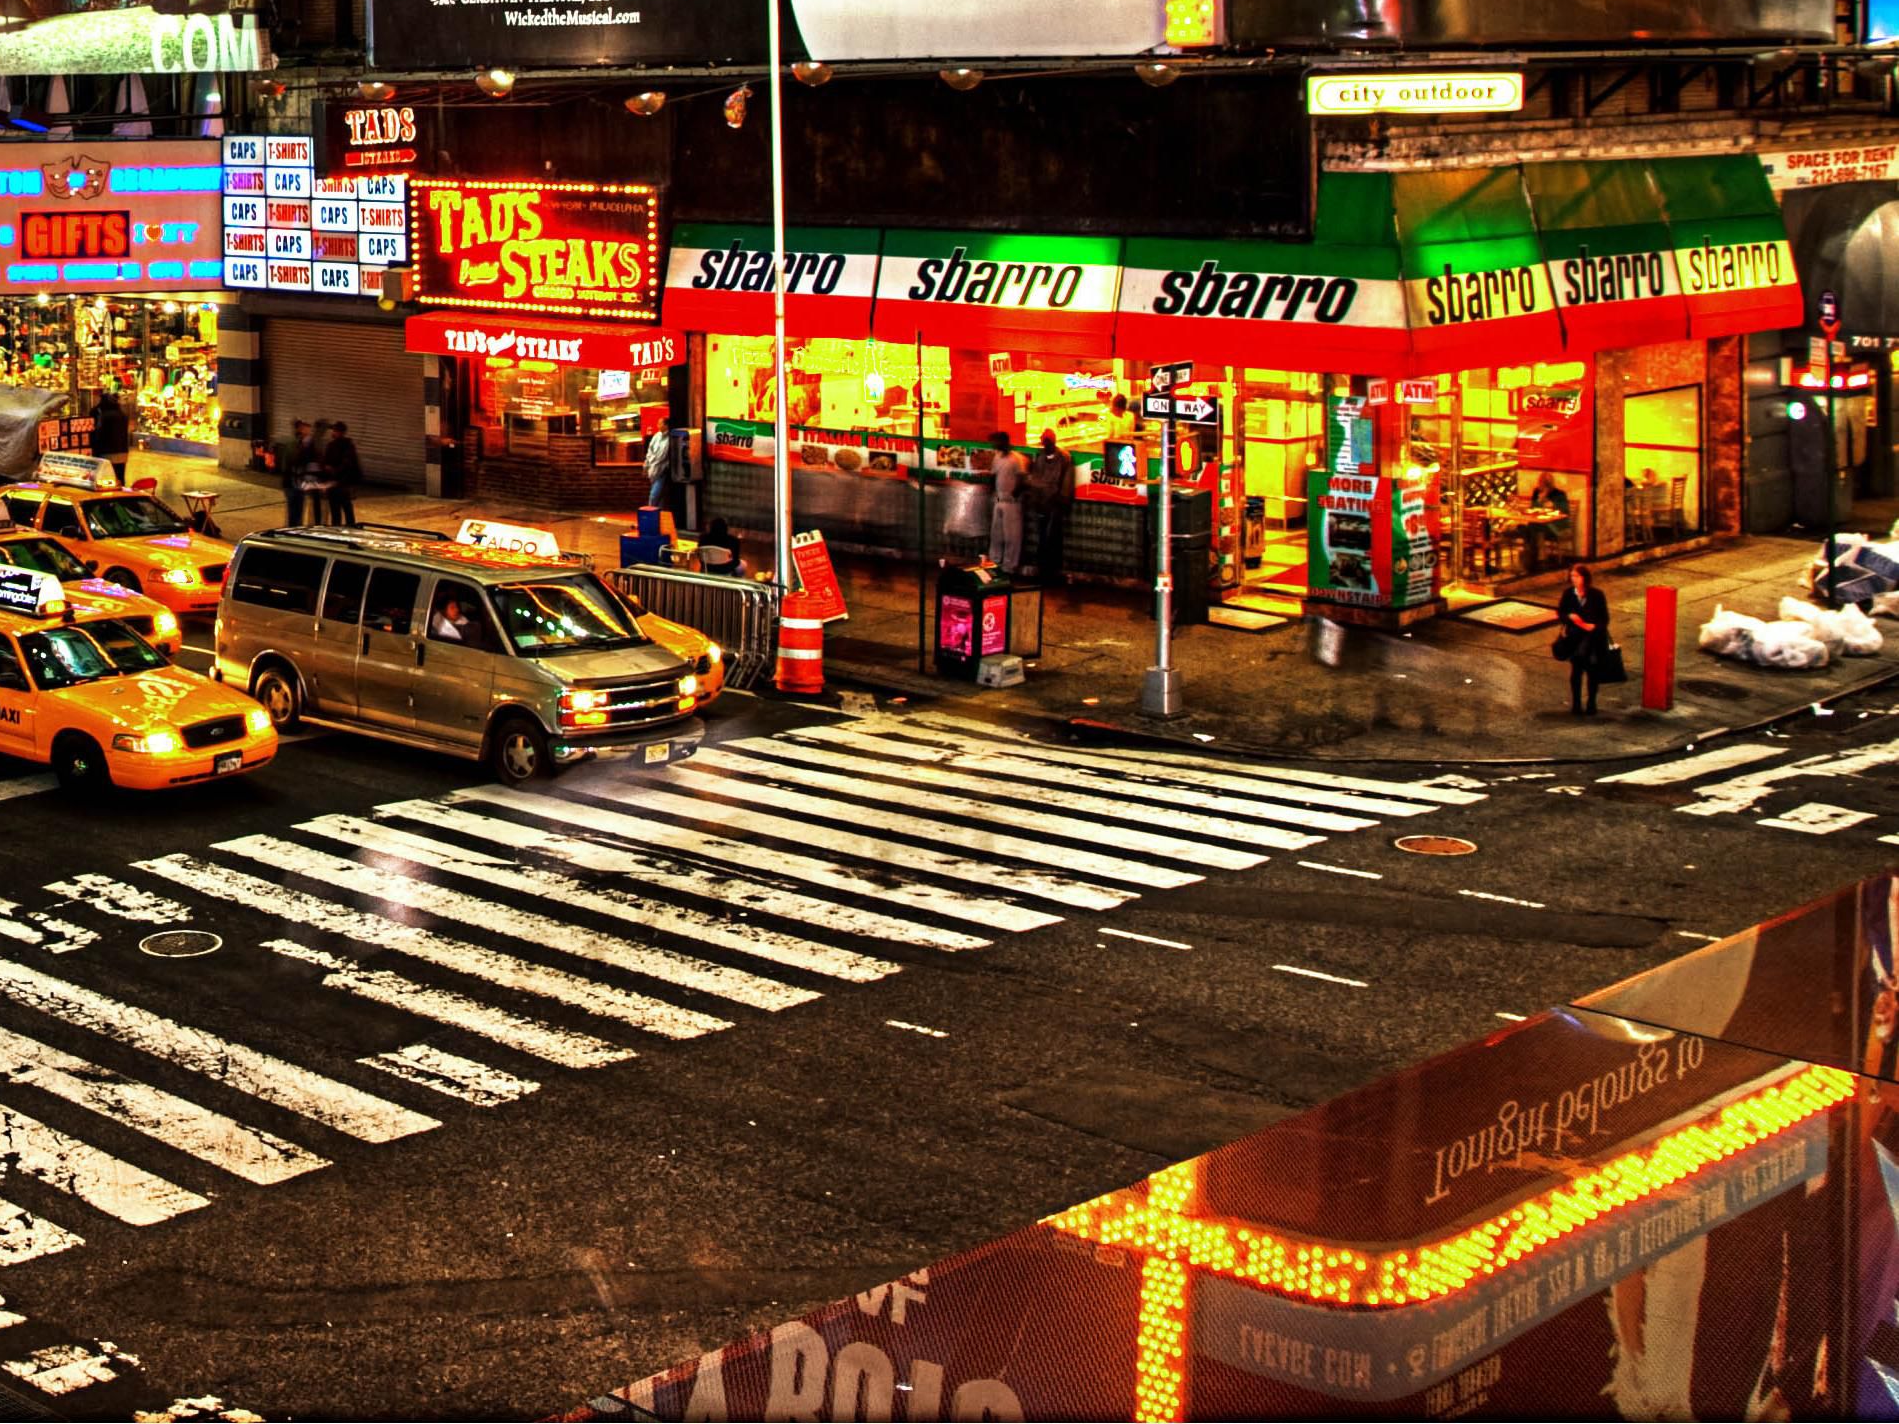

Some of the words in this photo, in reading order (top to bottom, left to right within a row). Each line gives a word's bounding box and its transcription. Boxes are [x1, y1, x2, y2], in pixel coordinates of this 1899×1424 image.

[505, 9, 640, 26] WickedtheMusical.com
[1338, 83, 1386, 104] city
[1398, 84, 1497, 101] outdoor
[345, 107, 416, 145] TADS
[230, 142, 256, 160] CAPS
[268, 142, 308, 161] T-SHIRTS
[1787, 153, 1830, 169] SPACE
[1833, 151, 1860, 164] FOR
[1863, 147, 1896, 163] RENT
[225, 173, 263, 190] T-SHIRTS
[275, 174, 300, 191] CAPS
[232, 203, 256, 220] CAPS
[268, 203, 308, 222] T-SHIRTS
[321, 206, 347, 224] CAPS
[360, 208, 403, 227] T-SHIRTS
[24, 214, 127, 257] GIFTS
[226, 233, 264, 252] T-SHIRTS
[276, 235, 302, 253] CAPS
[314, 237, 355, 256] T-SHIRTS
[369, 238, 396, 256] CAPS
[233, 264, 257, 281] CAPS
[270, 266, 309, 284] T-SHIRTS
[322, 269, 349, 287] CAPS
[500, 239, 641, 298] STEAKS
[692, 239, 846, 295] sbarro
[1564, 244, 1665, 307] sbarro
[1689, 235, 1780, 293] sbarro
[908, 247, 1083, 308] sbarro
[1151, 260, 1358, 324] sbarro
[1427, 265, 1536, 326] sbarro
[516, 336, 582, 362] STEAKS
[630, 336, 674, 366] TAD'S
[1404, 383, 1434, 401] ATM
[1184, 404, 1206, 414] WAY
[715, 430, 752, 448] sbarro
[487, 537, 537, 556] ALDO
